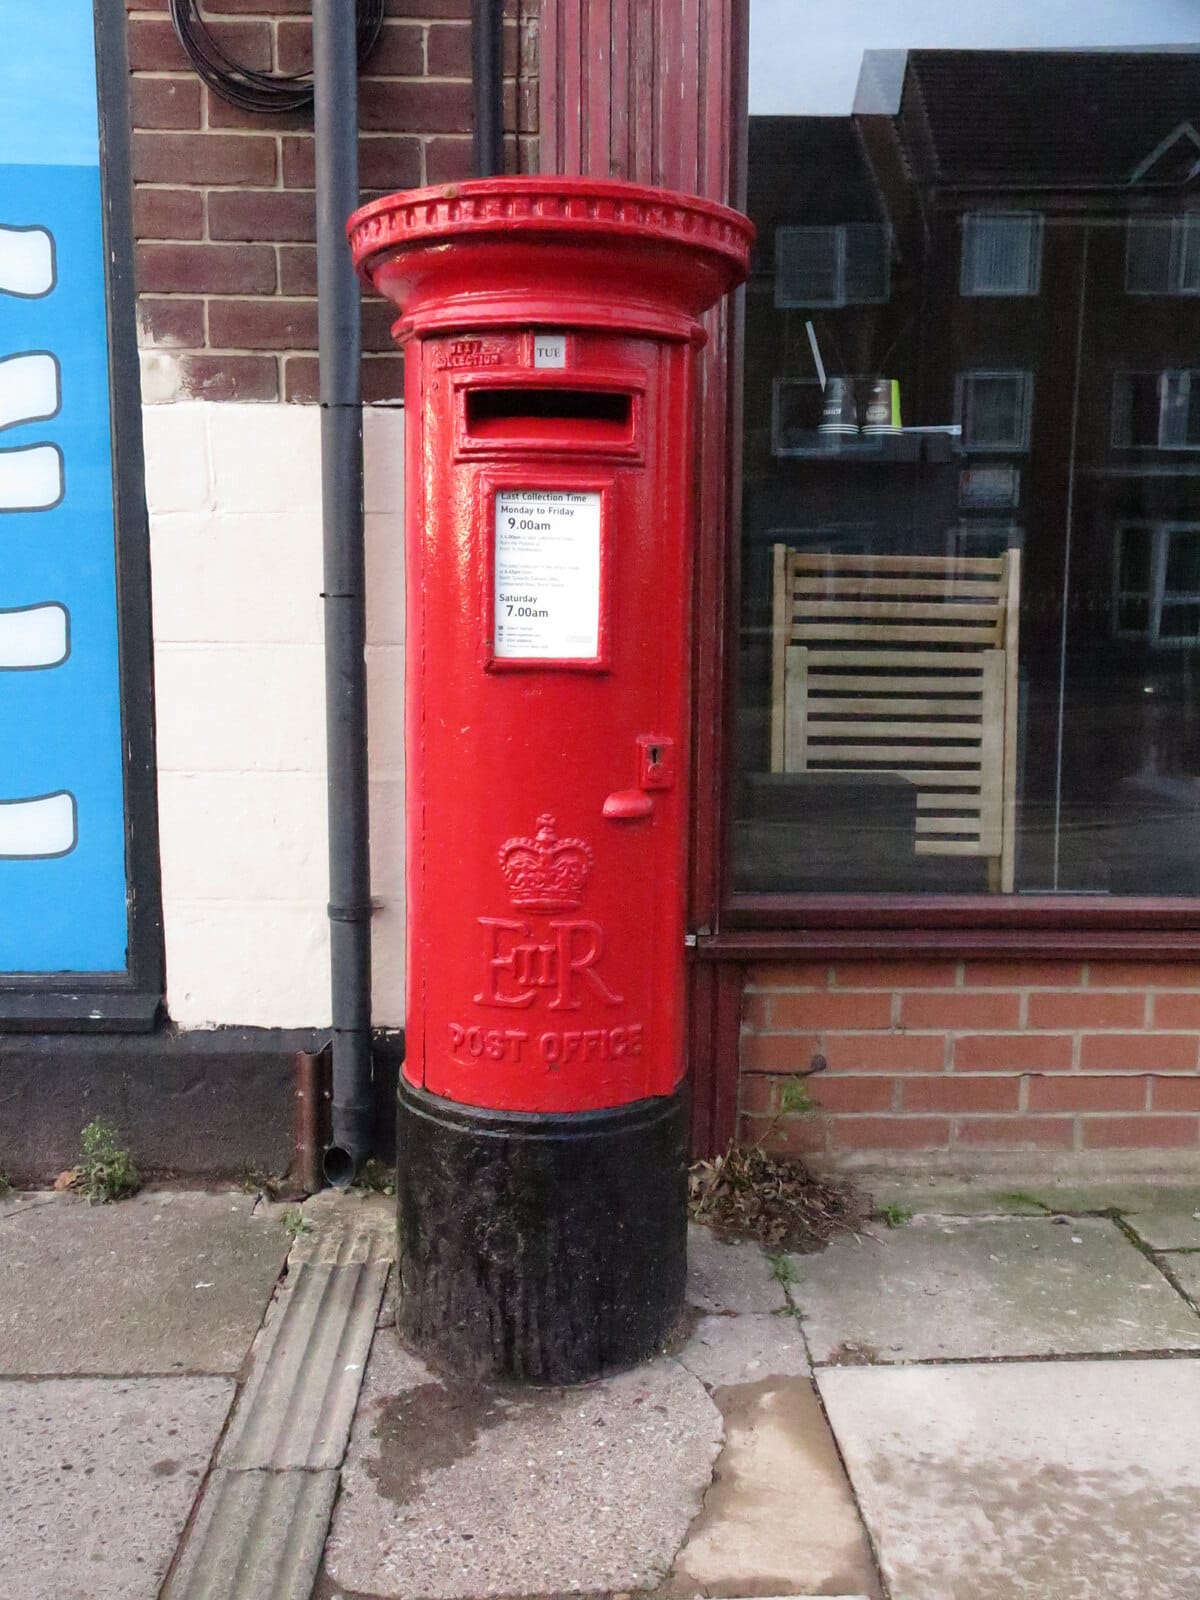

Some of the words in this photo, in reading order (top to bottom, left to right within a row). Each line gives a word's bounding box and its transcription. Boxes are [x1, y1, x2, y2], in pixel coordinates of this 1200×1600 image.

[536, 348, 561, 358] TUE
[501, 492, 520, 501] Last
[522, 492, 563, 502] Collection
[566, 493, 587, 502] Time
[501, 505, 534, 515] Monday
[548, 507, 575, 517] Friday
[508, 517, 551, 530] 9.00am
[499, 593, 538, 604] Saturday
[505, 604, 549, 618] 7.00am
[448, 1022, 529, 1063] POST
[539, 1023, 643, 1063] OFFICE
